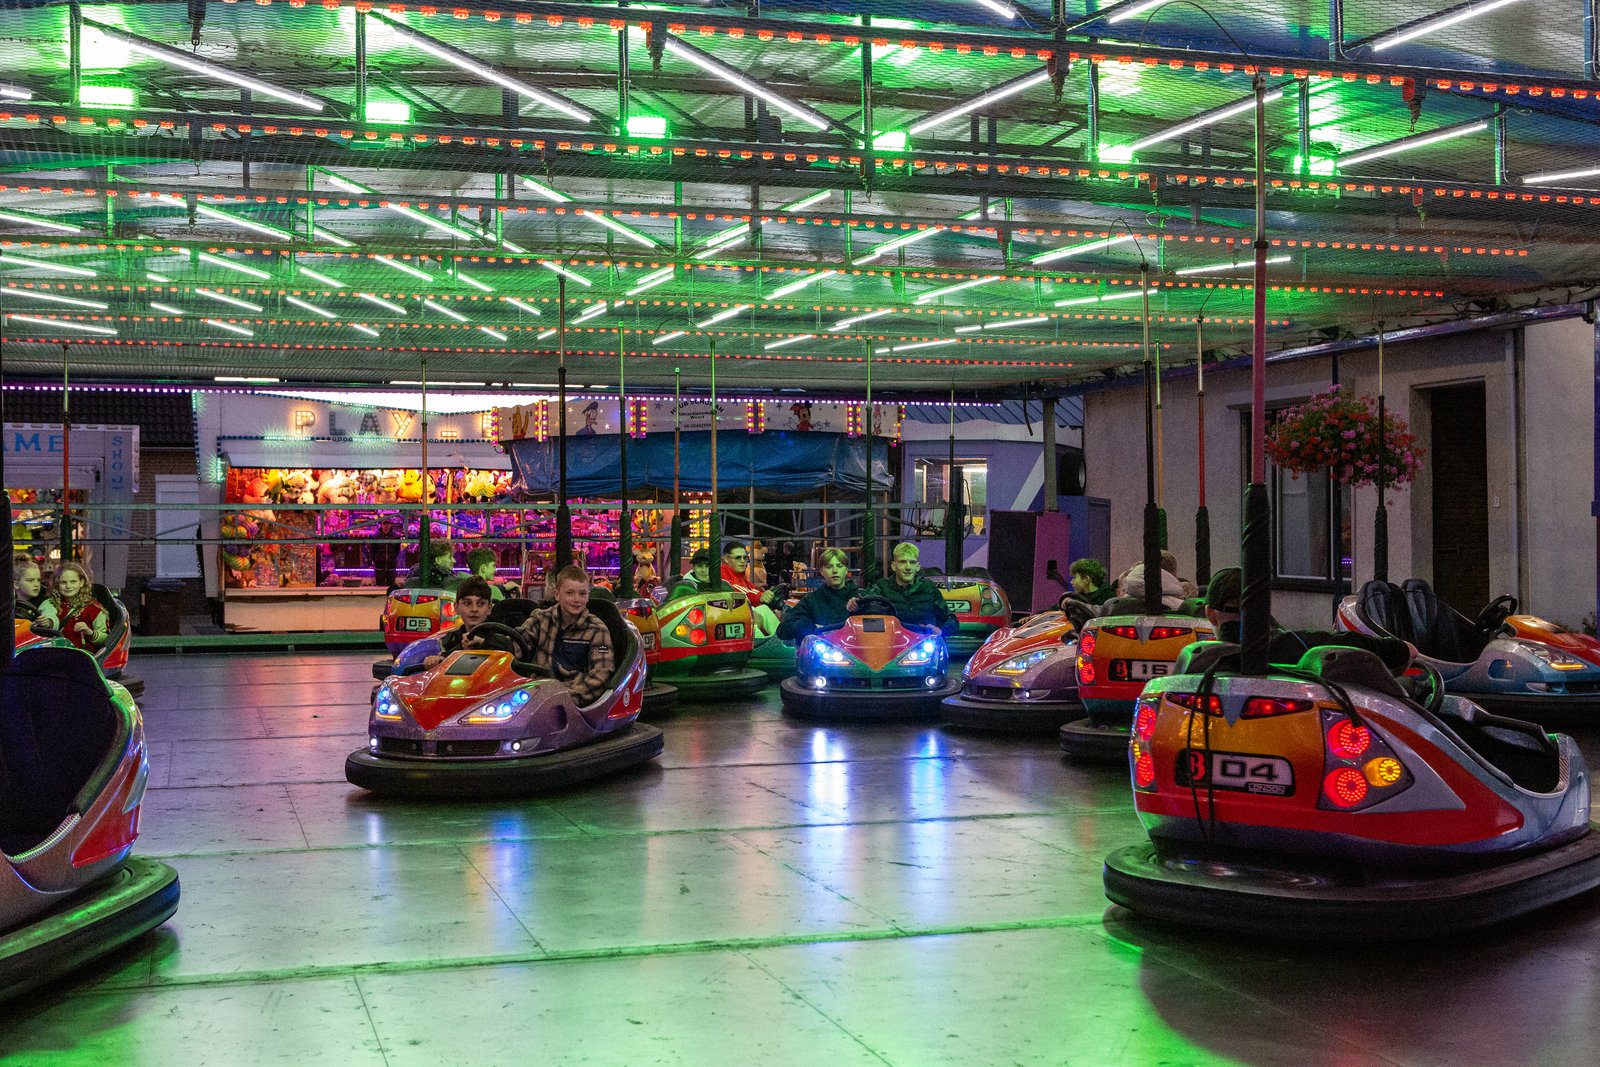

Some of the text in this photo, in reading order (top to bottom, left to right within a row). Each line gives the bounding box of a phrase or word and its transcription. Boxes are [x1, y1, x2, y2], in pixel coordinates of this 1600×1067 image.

[295, 410, 415, 437] PLAY
[2, 432, 65, 452] ME
[730, 625, 741, 634] 12
[1142, 663, 1168, 675] 16
[1221, 760, 1278, 782] 04
